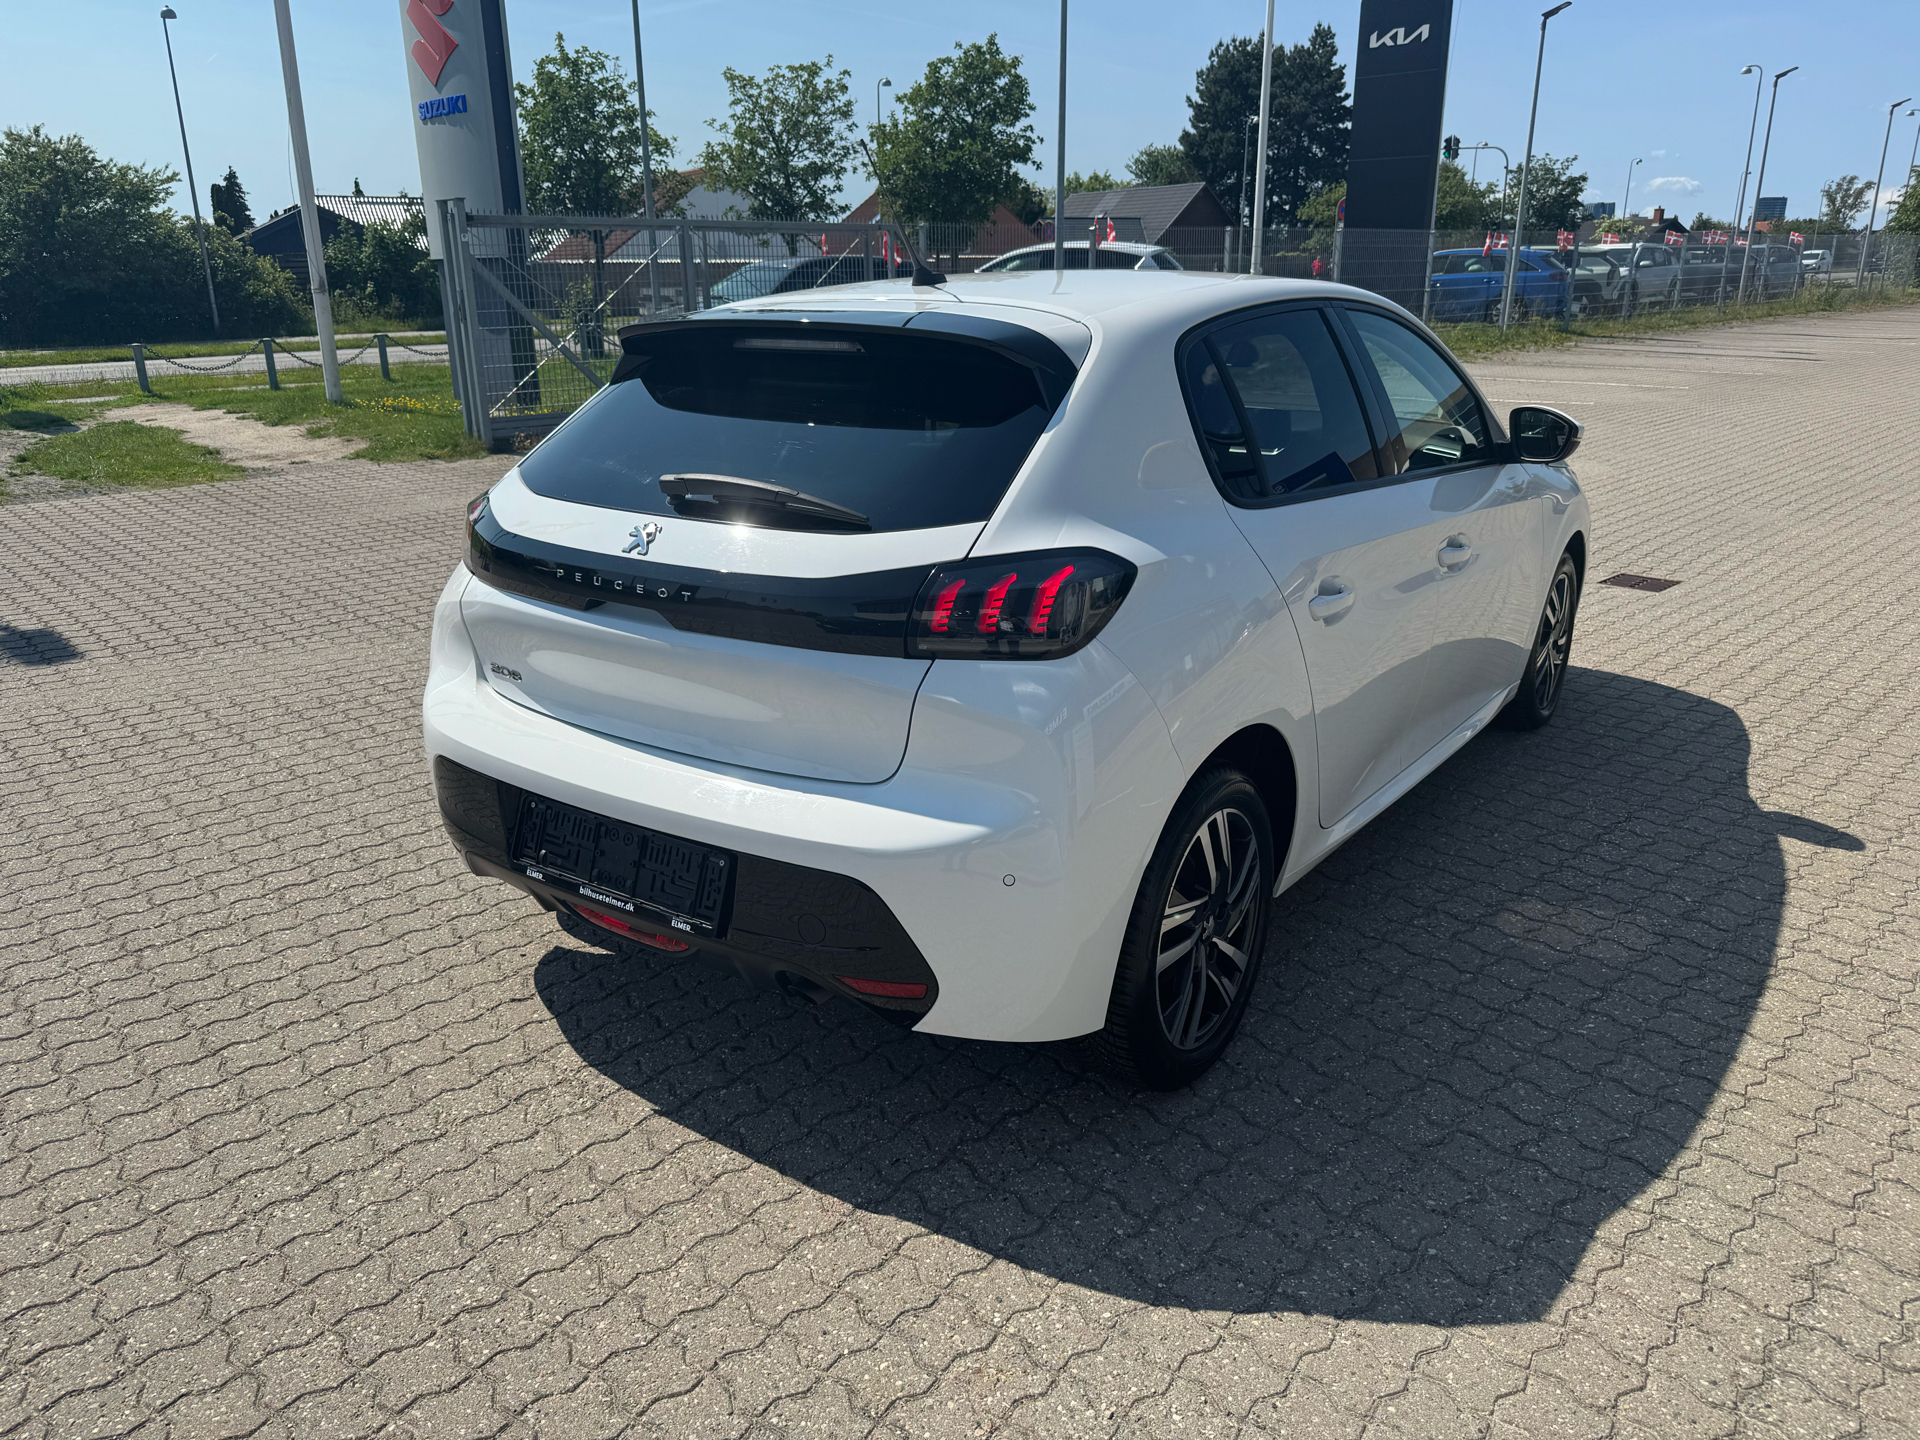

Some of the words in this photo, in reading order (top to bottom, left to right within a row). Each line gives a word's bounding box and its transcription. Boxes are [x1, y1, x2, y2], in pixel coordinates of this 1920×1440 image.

[1368, 23, 1430, 49] KIA
[417, 93, 468, 121] SUZUKI
[556, 568, 692, 602] PEUGEOT
[490, 661, 523, 683] 208
[579, 885, 635, 913] bilhusetelmer.dk
[671, 919, 695, 934] ELMER
